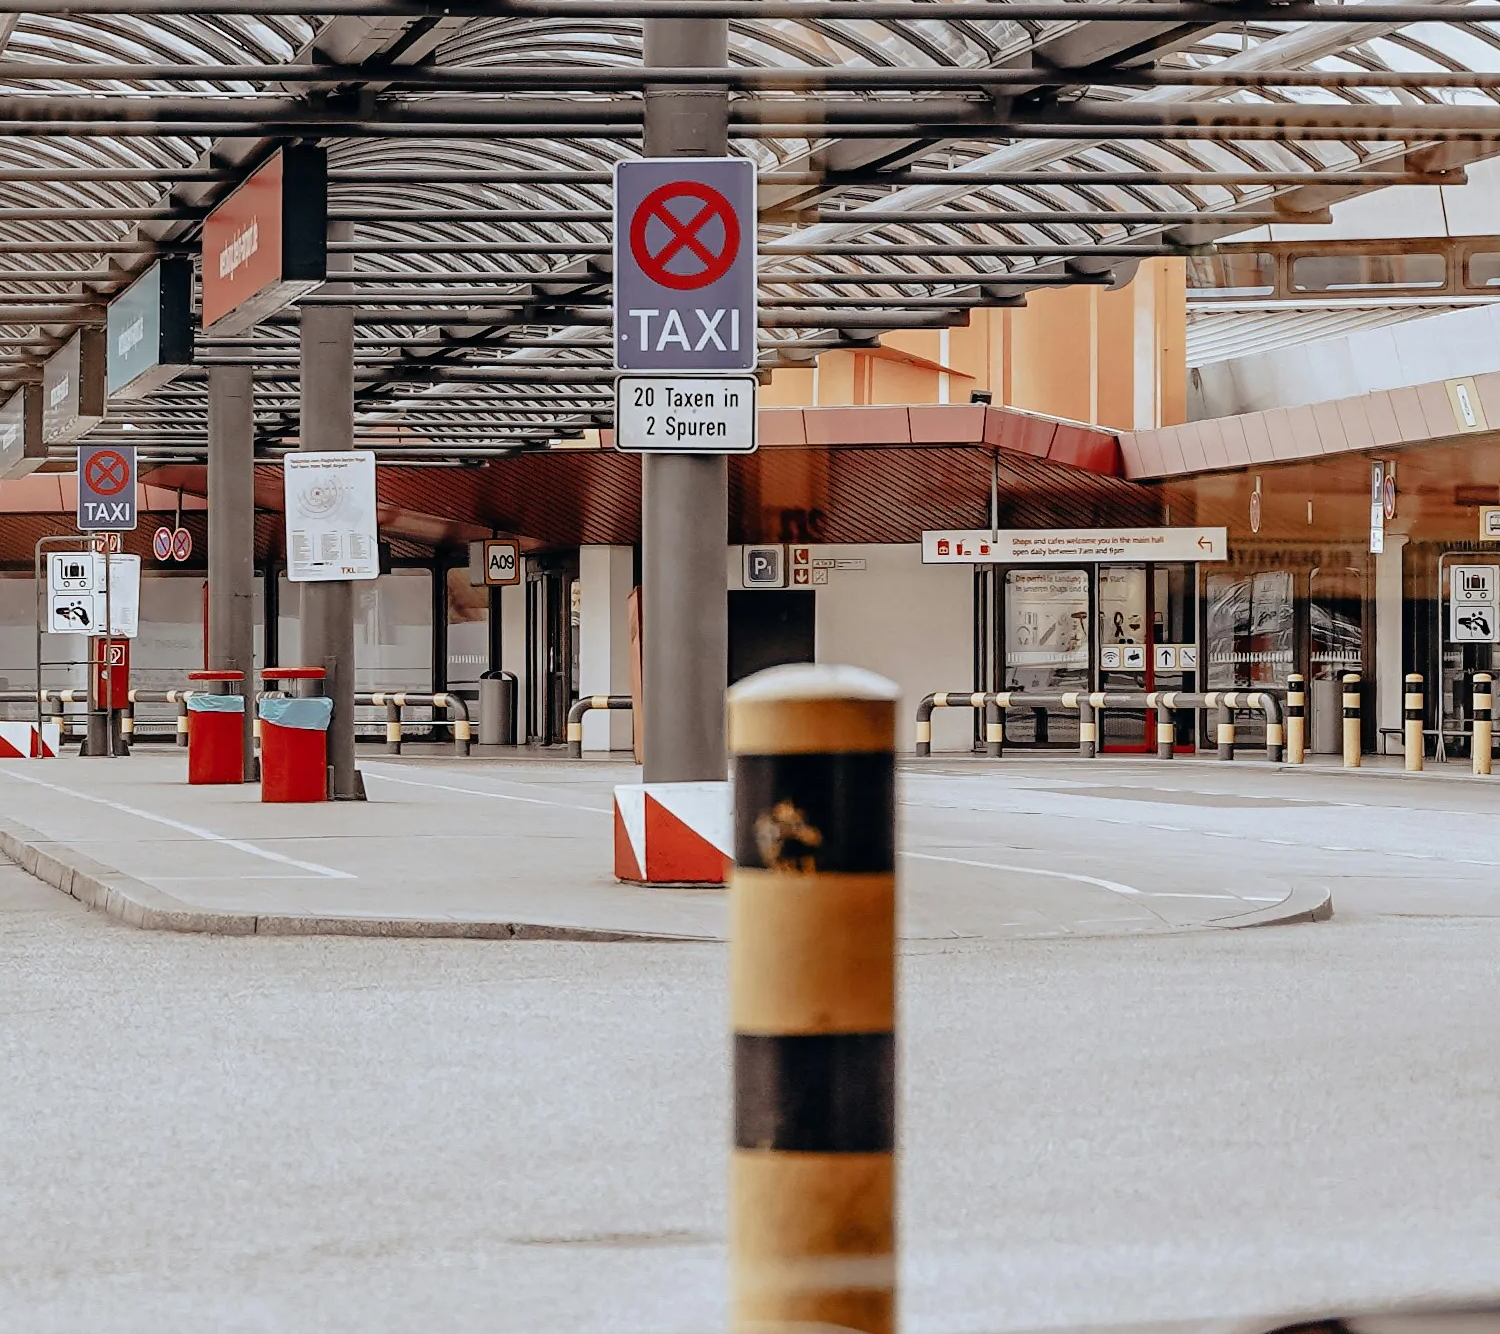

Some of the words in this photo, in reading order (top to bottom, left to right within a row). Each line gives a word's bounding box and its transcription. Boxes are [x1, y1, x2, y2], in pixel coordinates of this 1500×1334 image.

[628, 308, 740, 352] TAXI
[634, 387, 655, 407] 20
[665, 388, 714, 407] Taxen
[724, 388, 739, 407] in
[646, 416, 656, 436] 2
[665, 416, 727, 441] Spuren
[83, 502, 130, 521] TAXI
[490, 555, 514, 569] A09
